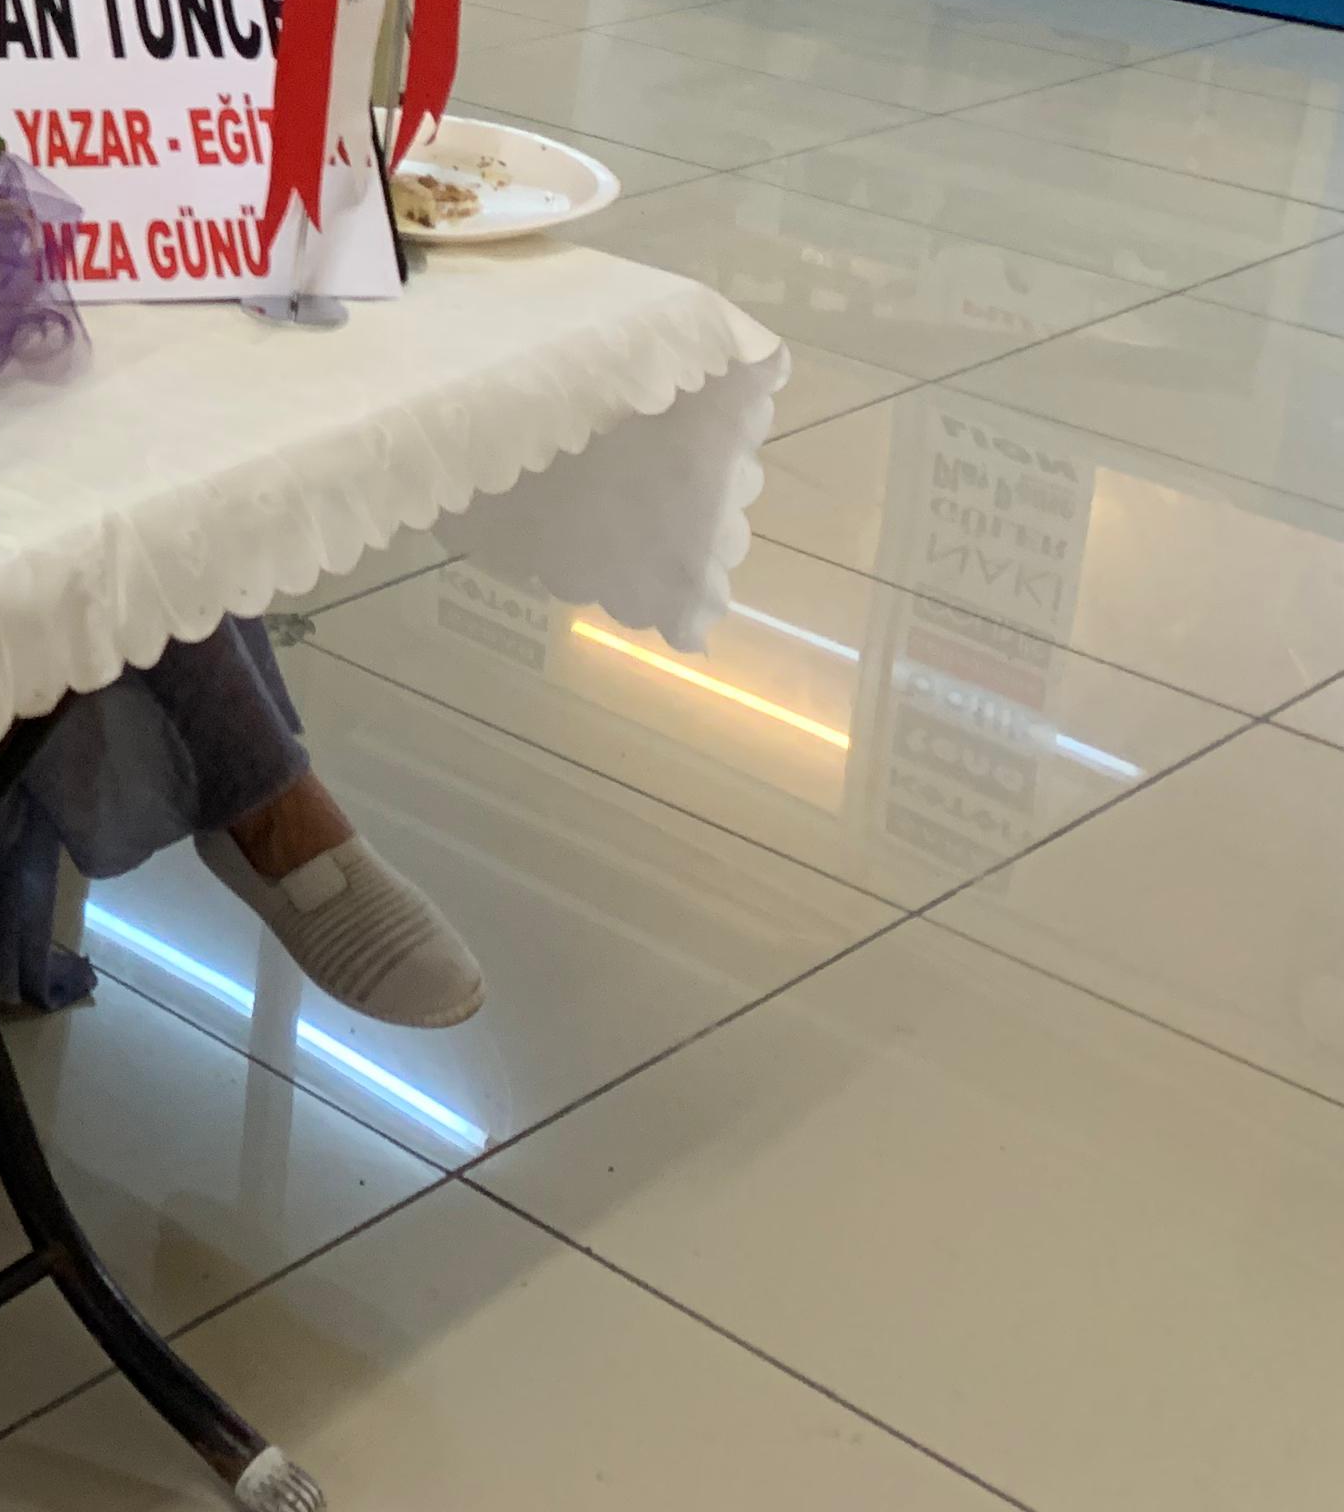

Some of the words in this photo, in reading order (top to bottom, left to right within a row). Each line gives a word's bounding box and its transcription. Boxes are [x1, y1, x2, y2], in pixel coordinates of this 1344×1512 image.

[14, 109, 158, 167] YAZAR
[167, 139, 180, 151] -
[147, 206, 271, 280] GÜNÜ
